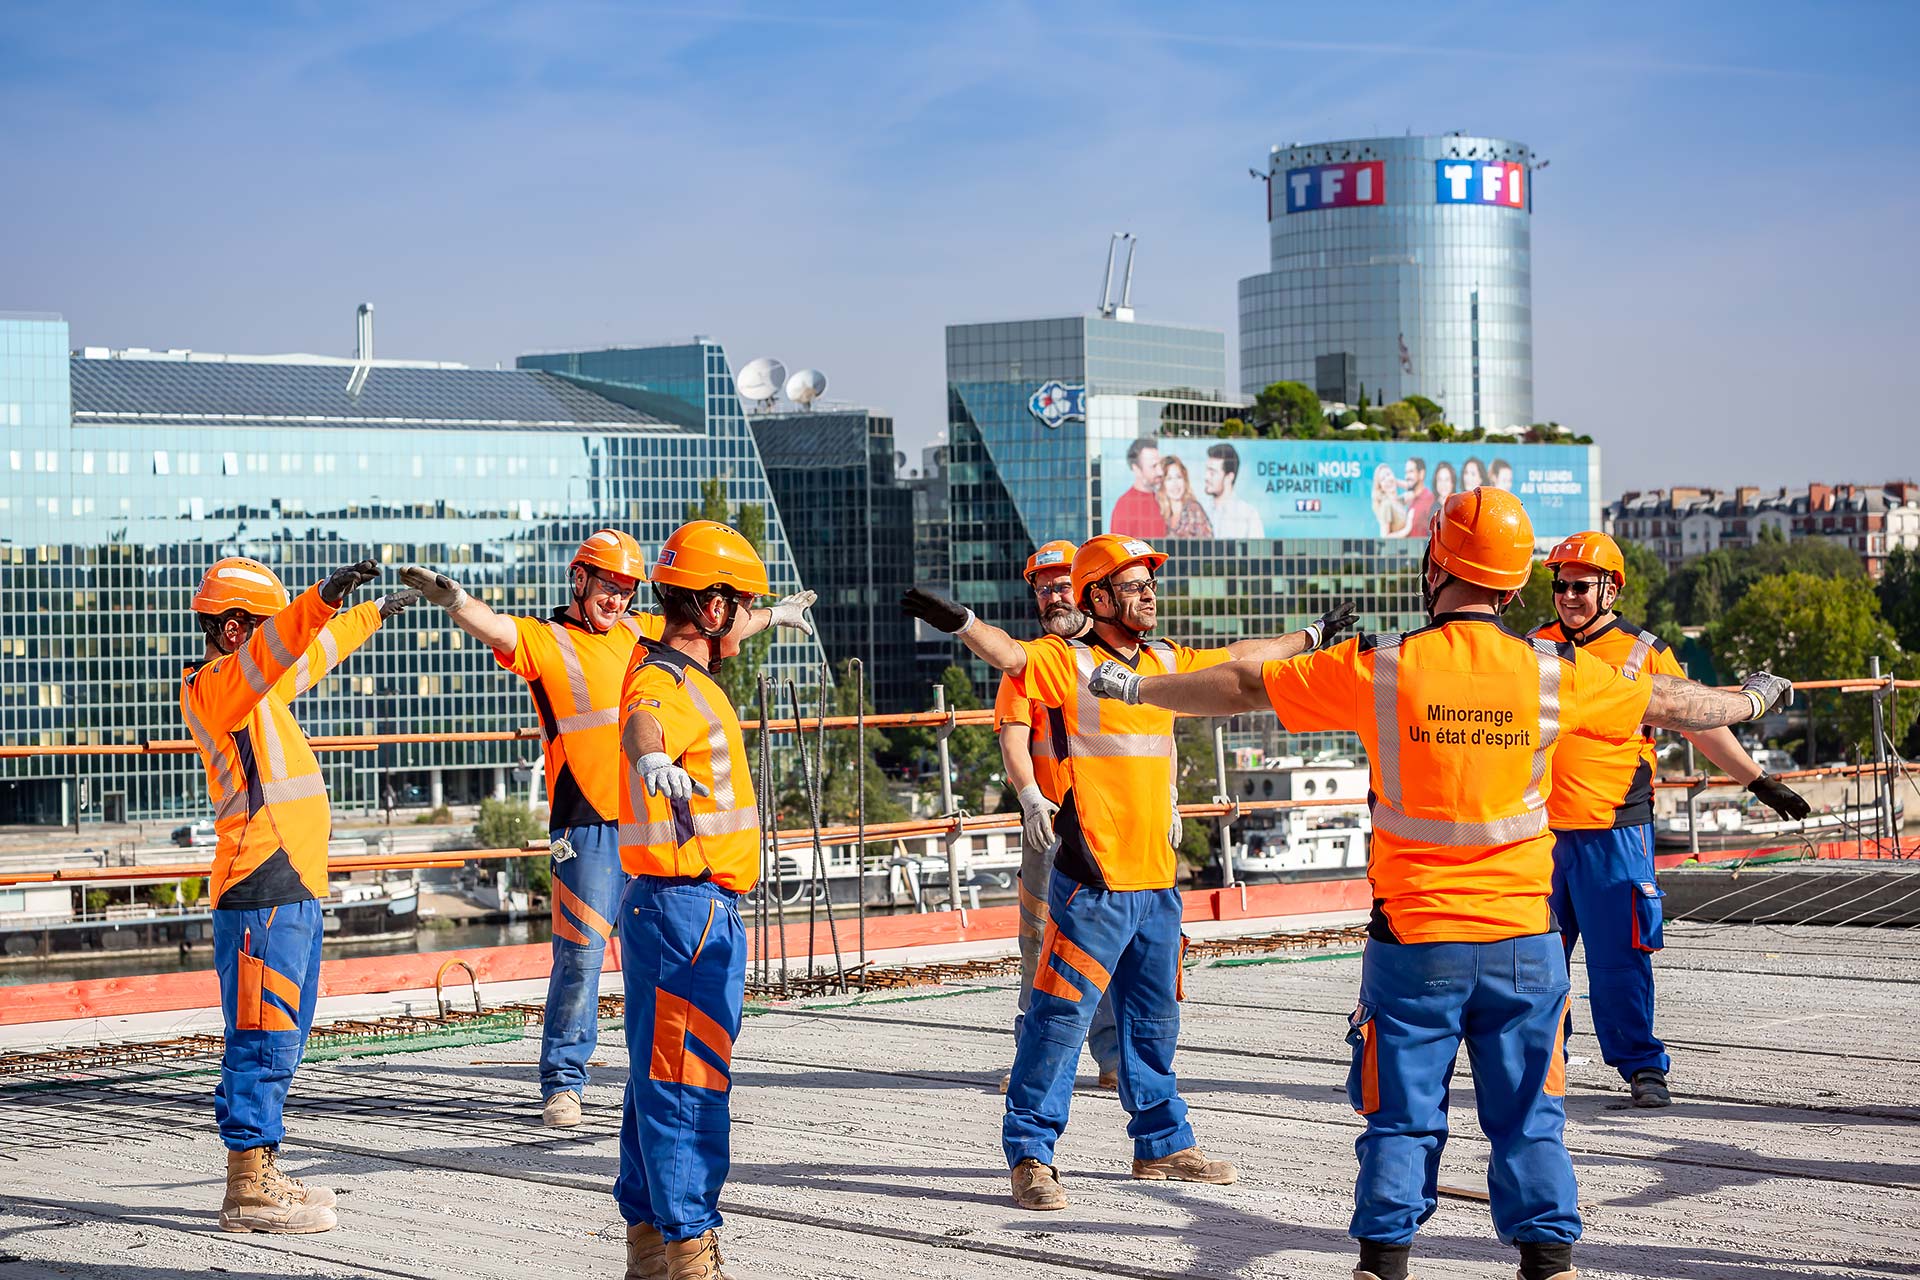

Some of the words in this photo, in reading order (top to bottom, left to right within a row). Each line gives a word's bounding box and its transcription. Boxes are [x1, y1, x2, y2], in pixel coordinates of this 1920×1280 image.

[1290, 167, 1372, 207] TF1
[1444, 164, 1521, 203] TF1
[1257, 462, 1315, 476] DEMAIN
[1317, 461, 1361, 478] NOUS
[1265, 479, 1352, 493] APPARTIENT
[1427, 704, 1513, 727] Minorange
[1409, 725, 1430, 743] Un
[1436, 727, 1466, 744] état
[1471, 729, 1530, 749] d'esprit
